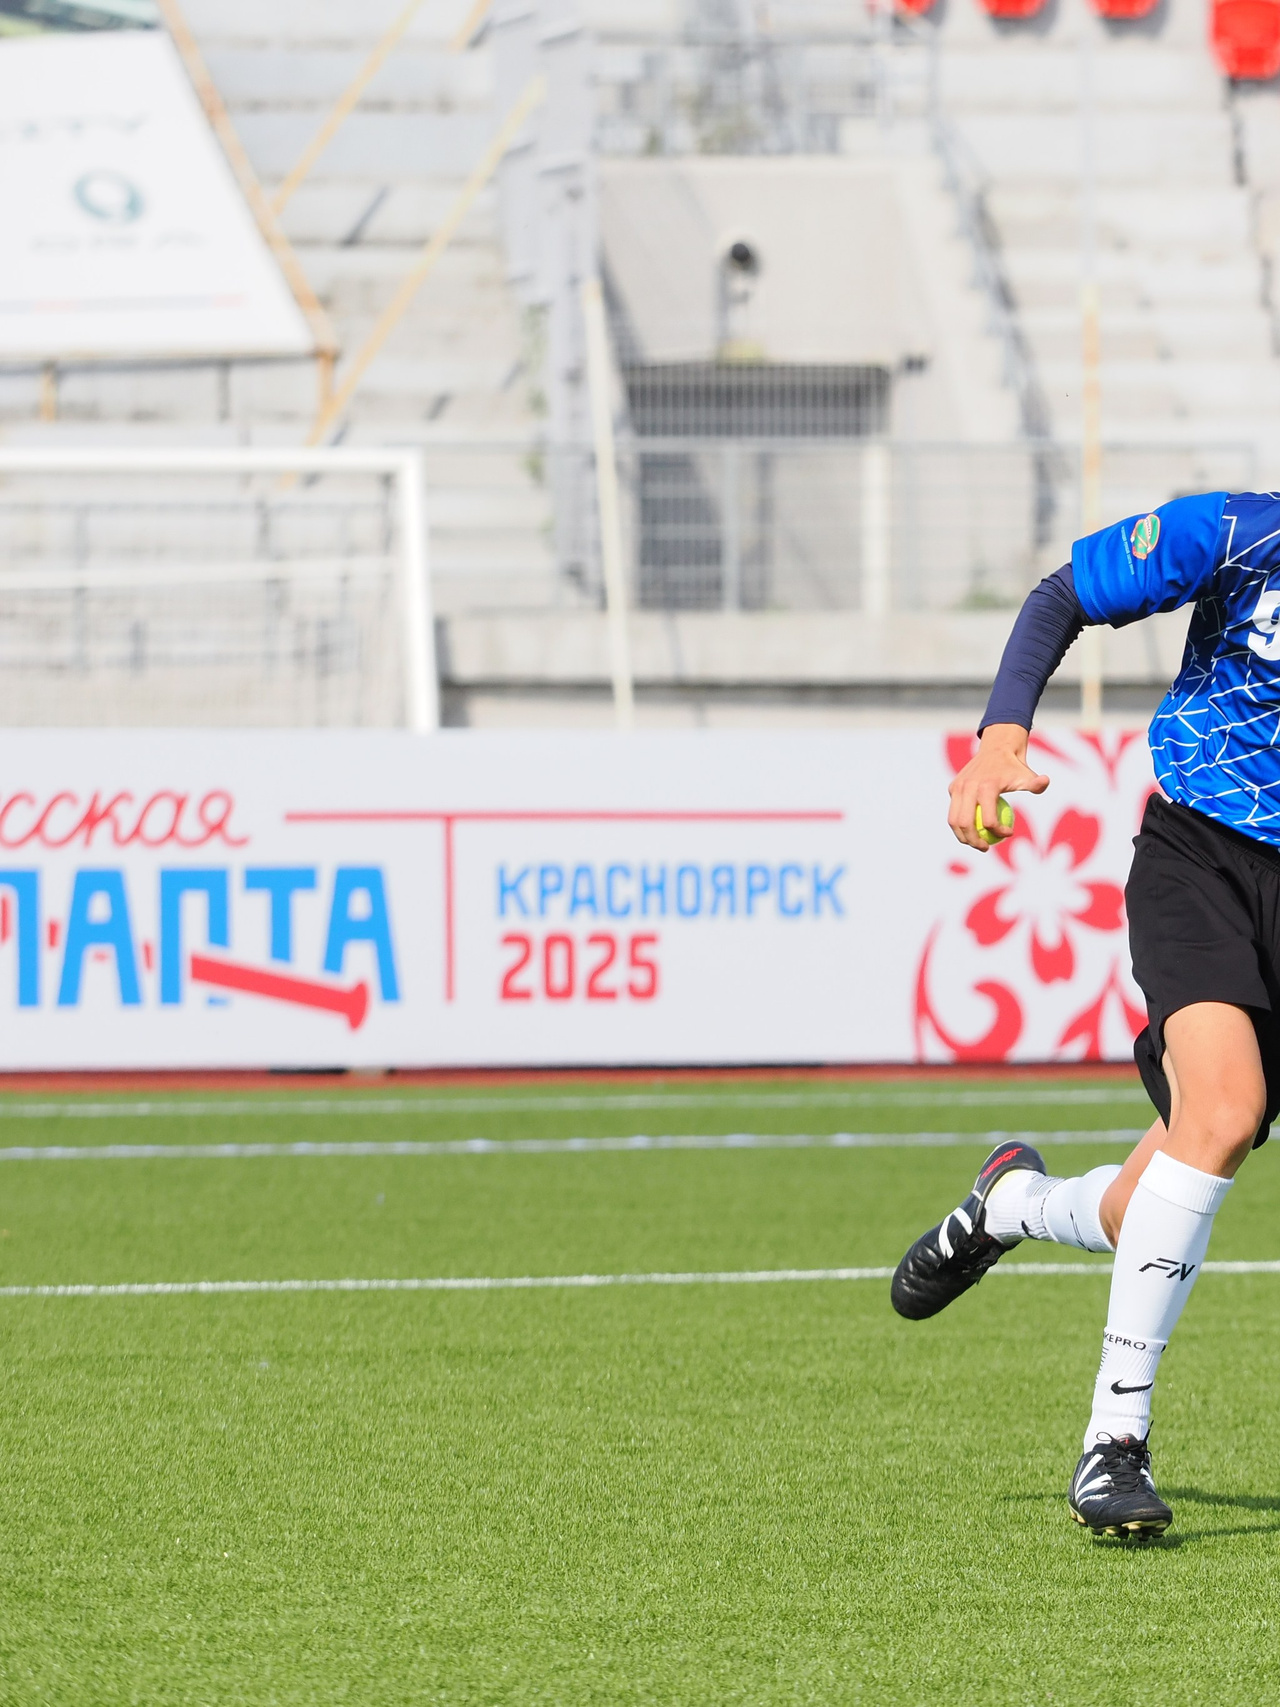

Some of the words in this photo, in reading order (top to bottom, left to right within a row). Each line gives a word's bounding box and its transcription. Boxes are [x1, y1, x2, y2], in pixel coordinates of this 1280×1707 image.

[0, 789, 252, 848] сская
[496, 863, 846, 918] КРАСНОЯРСК
[500, 933, 661, 1002] 2025
